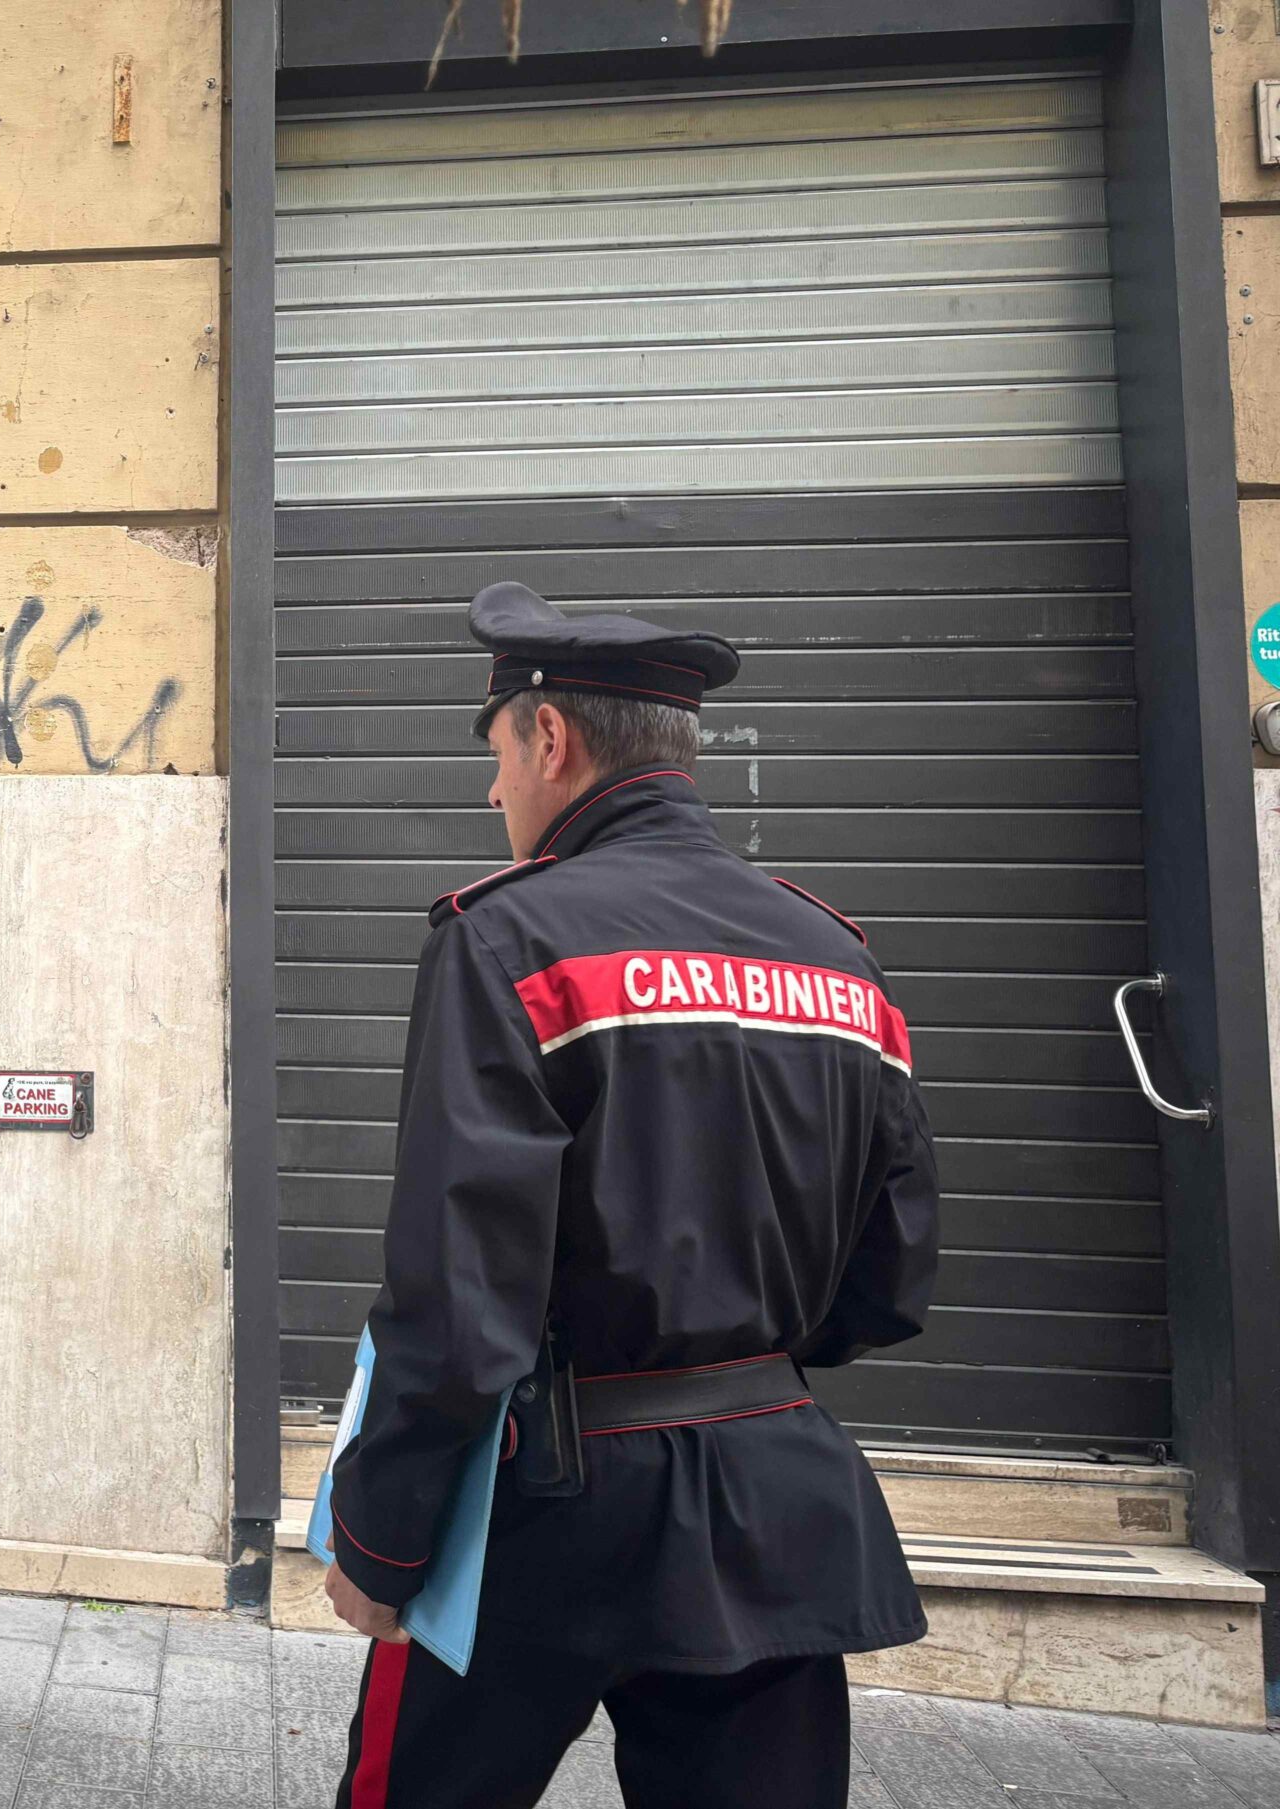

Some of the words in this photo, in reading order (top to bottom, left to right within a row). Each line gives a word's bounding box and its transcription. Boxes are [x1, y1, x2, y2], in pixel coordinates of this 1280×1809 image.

[1257, 627, 1280, 642] Rit
[622, 956, 878, 1034] CARABINIERI
[16, 1088, 56, 1101] CANE
[3, 1102, 69, 1115] PARKING
